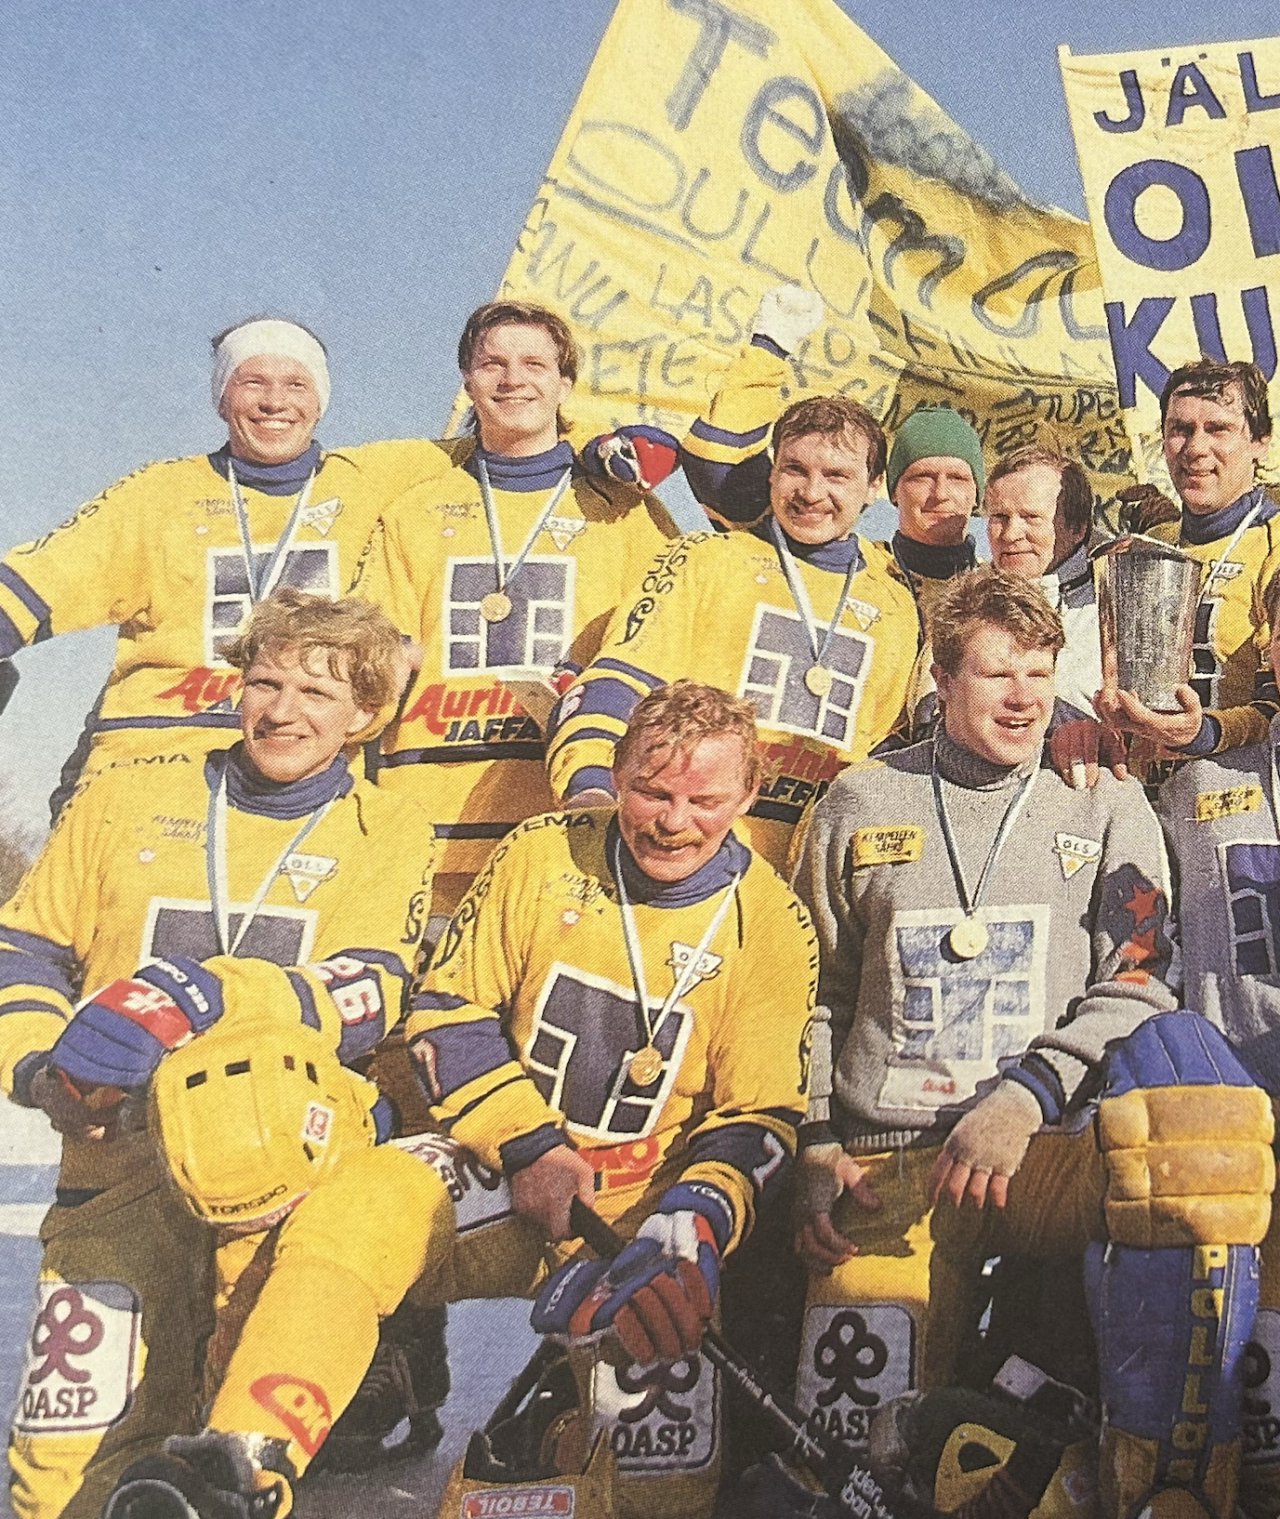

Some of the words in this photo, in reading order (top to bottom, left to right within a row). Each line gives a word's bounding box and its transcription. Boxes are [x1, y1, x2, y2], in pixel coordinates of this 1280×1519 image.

[1062, 838, 1090, 854] OLS
[23, 1386, 98, 1419] OASP
[610, 1422, 697, 1457] OASP
[807, 1406, 878, 1440] OAS
